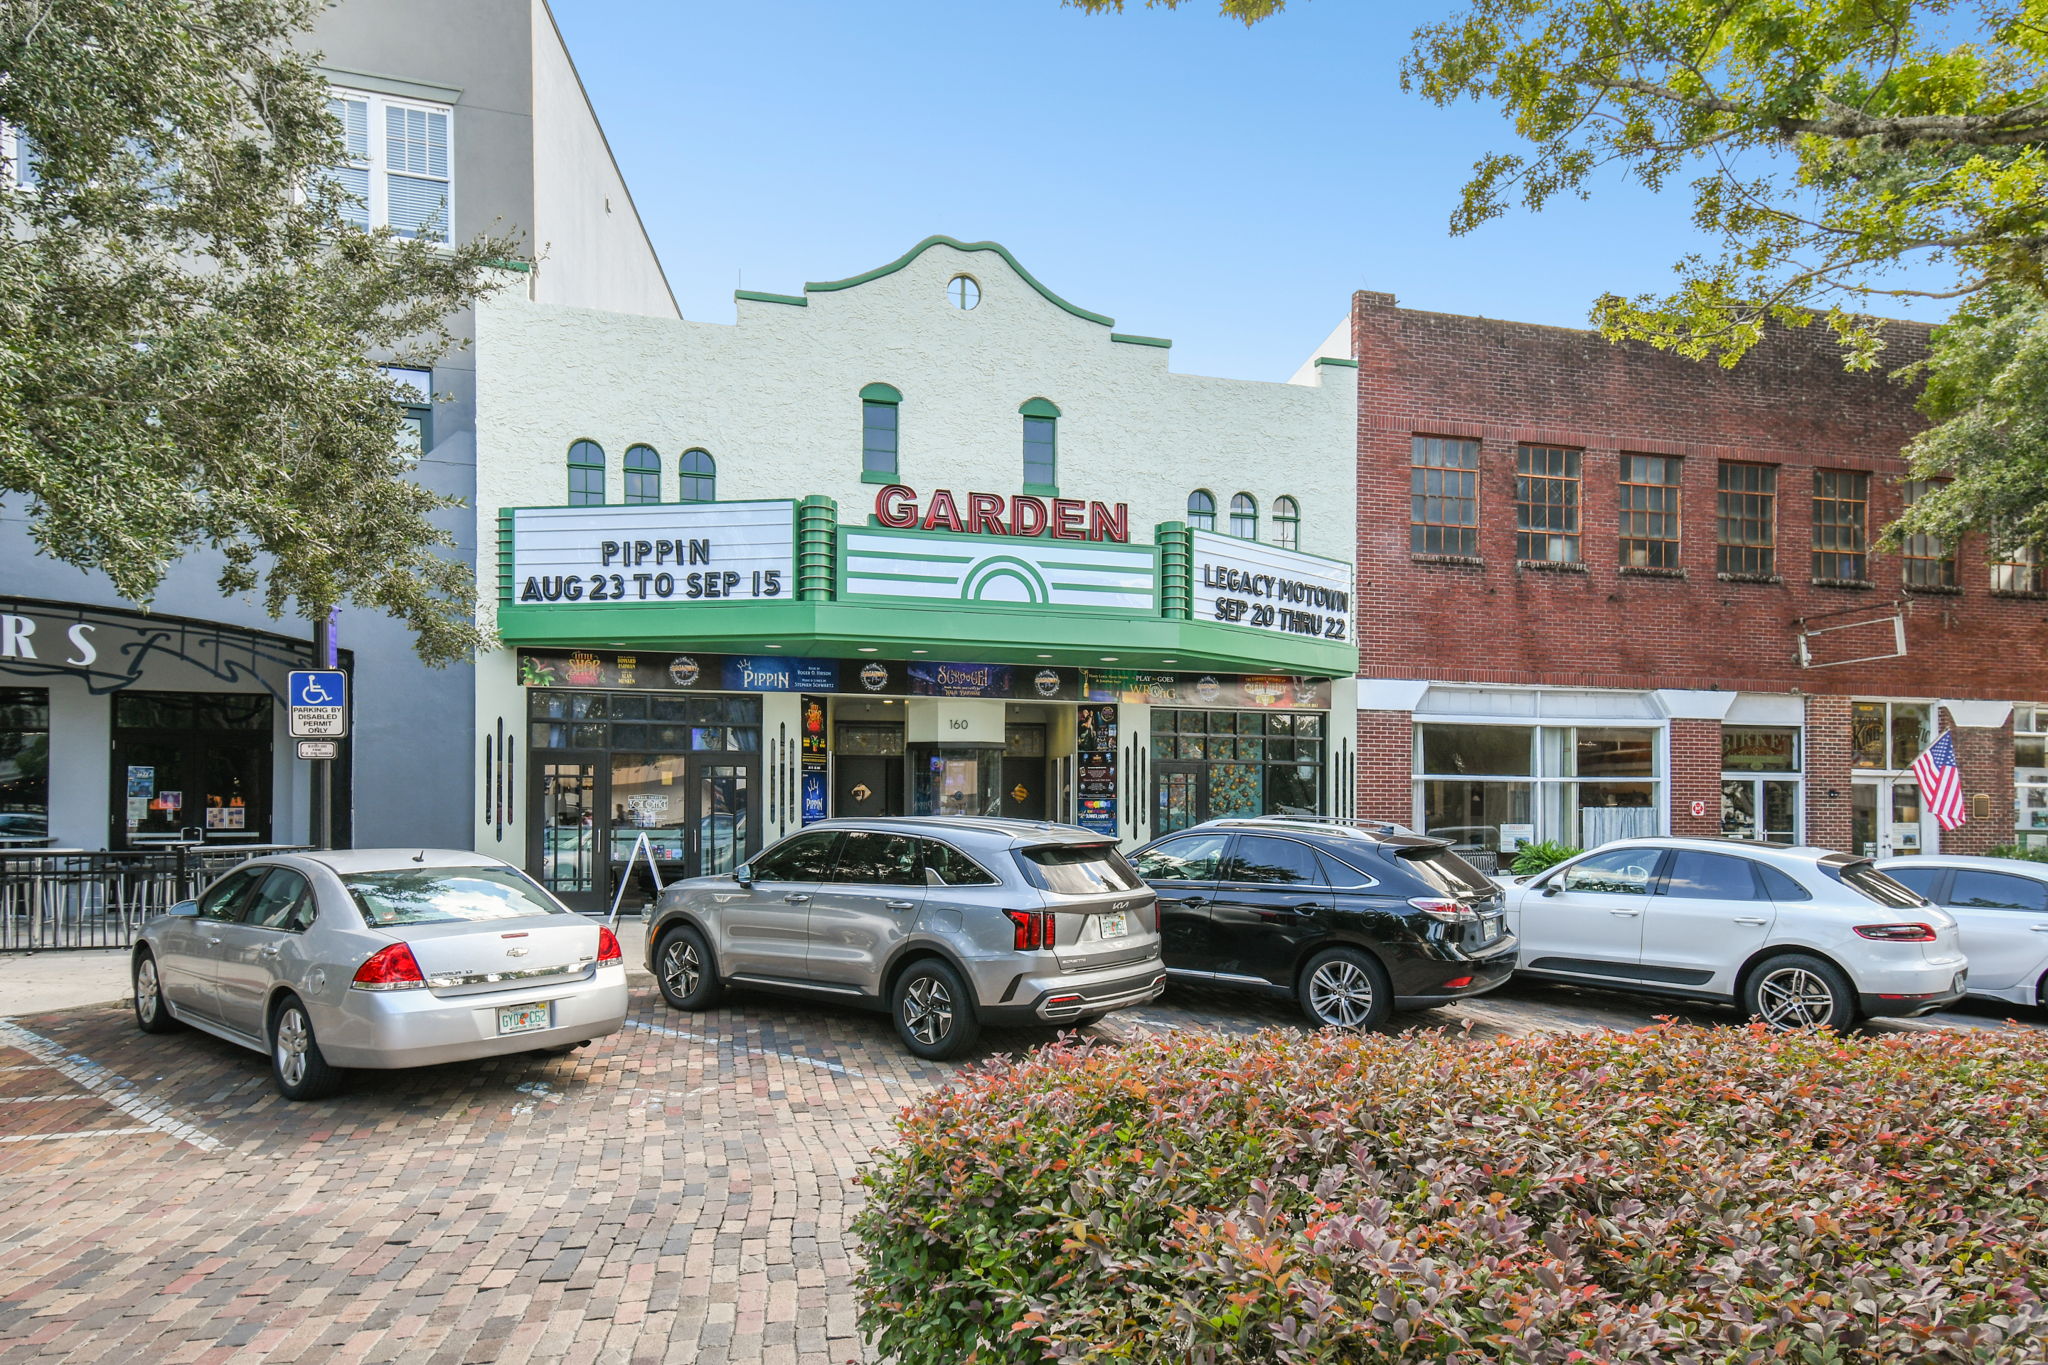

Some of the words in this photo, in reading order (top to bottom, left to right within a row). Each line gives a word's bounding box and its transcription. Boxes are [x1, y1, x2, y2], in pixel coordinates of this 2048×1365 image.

[875, 484, 1128, 543] GARDEN
[601, 538, 710, 567] PIPPIN
[521, 574, 583, 602] AUG
[589, 573, 625, 600] 23
[633, 572, 674, 599] TO
[687, 571, 741, 598] SEP
[752, 570, 782, 597] 15
[1204, 563, 1276, 598] LEGACY
[1278, 578, 1349, 613] MOTOWN
[1215, 597, 1248, 622] SEP
[1251, 603, 1275, 627] 20
[1279, 608, 1322, 636] THRU
[1325, 616, 1346, 640] 22
[743, 670, 790, 688] PIPPIN
[949, 719, 968, 730] 160
[1112, 901, 1130, 910] KIA
